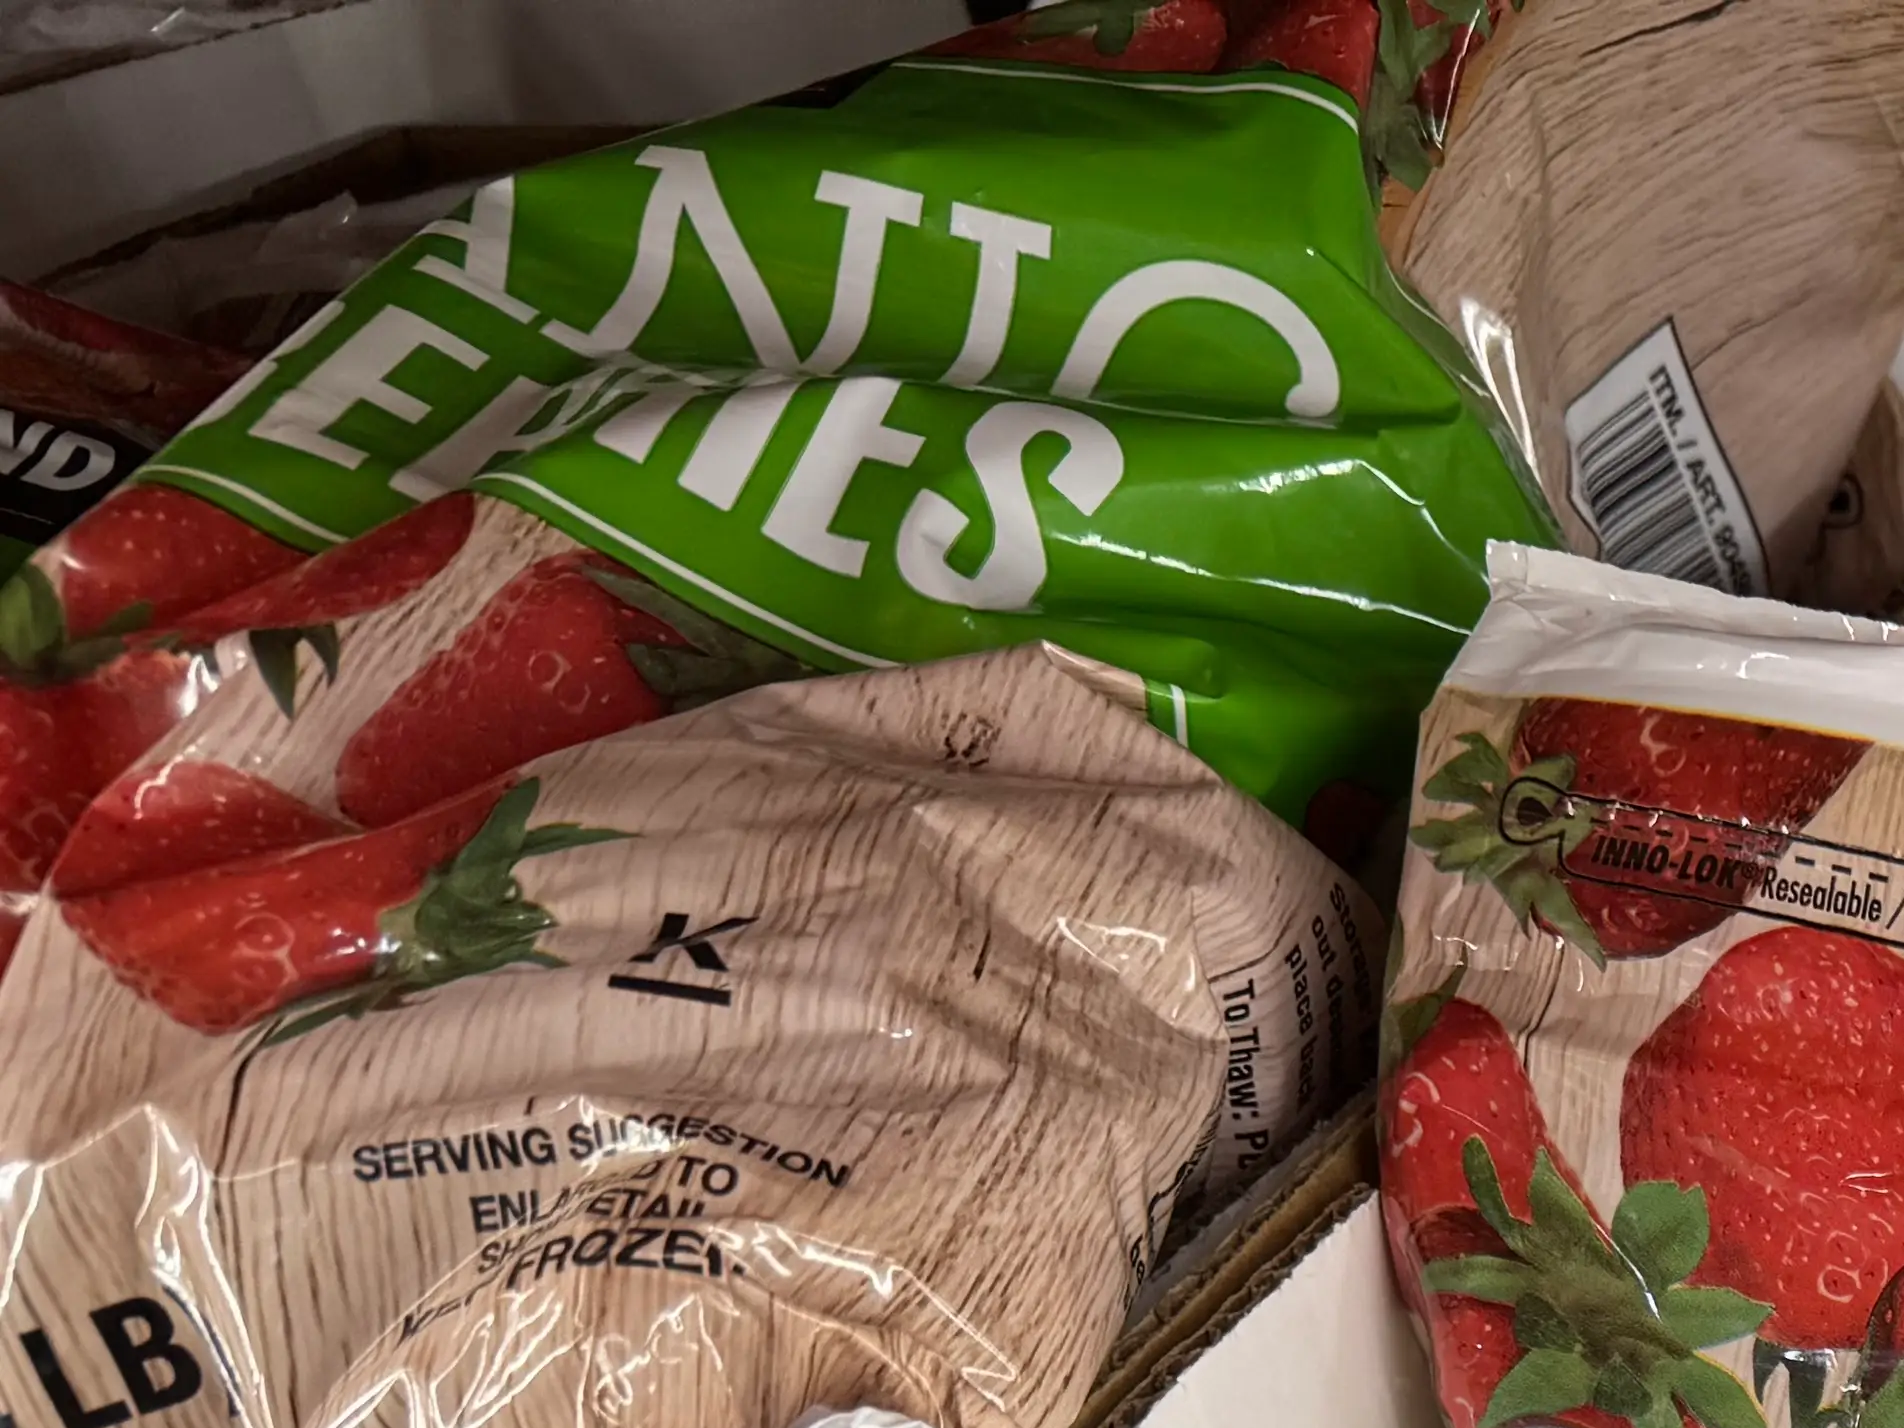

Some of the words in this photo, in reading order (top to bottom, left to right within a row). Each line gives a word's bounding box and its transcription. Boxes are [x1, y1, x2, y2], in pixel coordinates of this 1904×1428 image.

[1760, 866, 1883, 924] Resealable
[1222, 978, 1256, 1024] To
[1228, 1025, 1263, 1122] Thaw:
[353, 1126, 558, 1183] SERVING
[678, 1155, 740, 1198] TO
